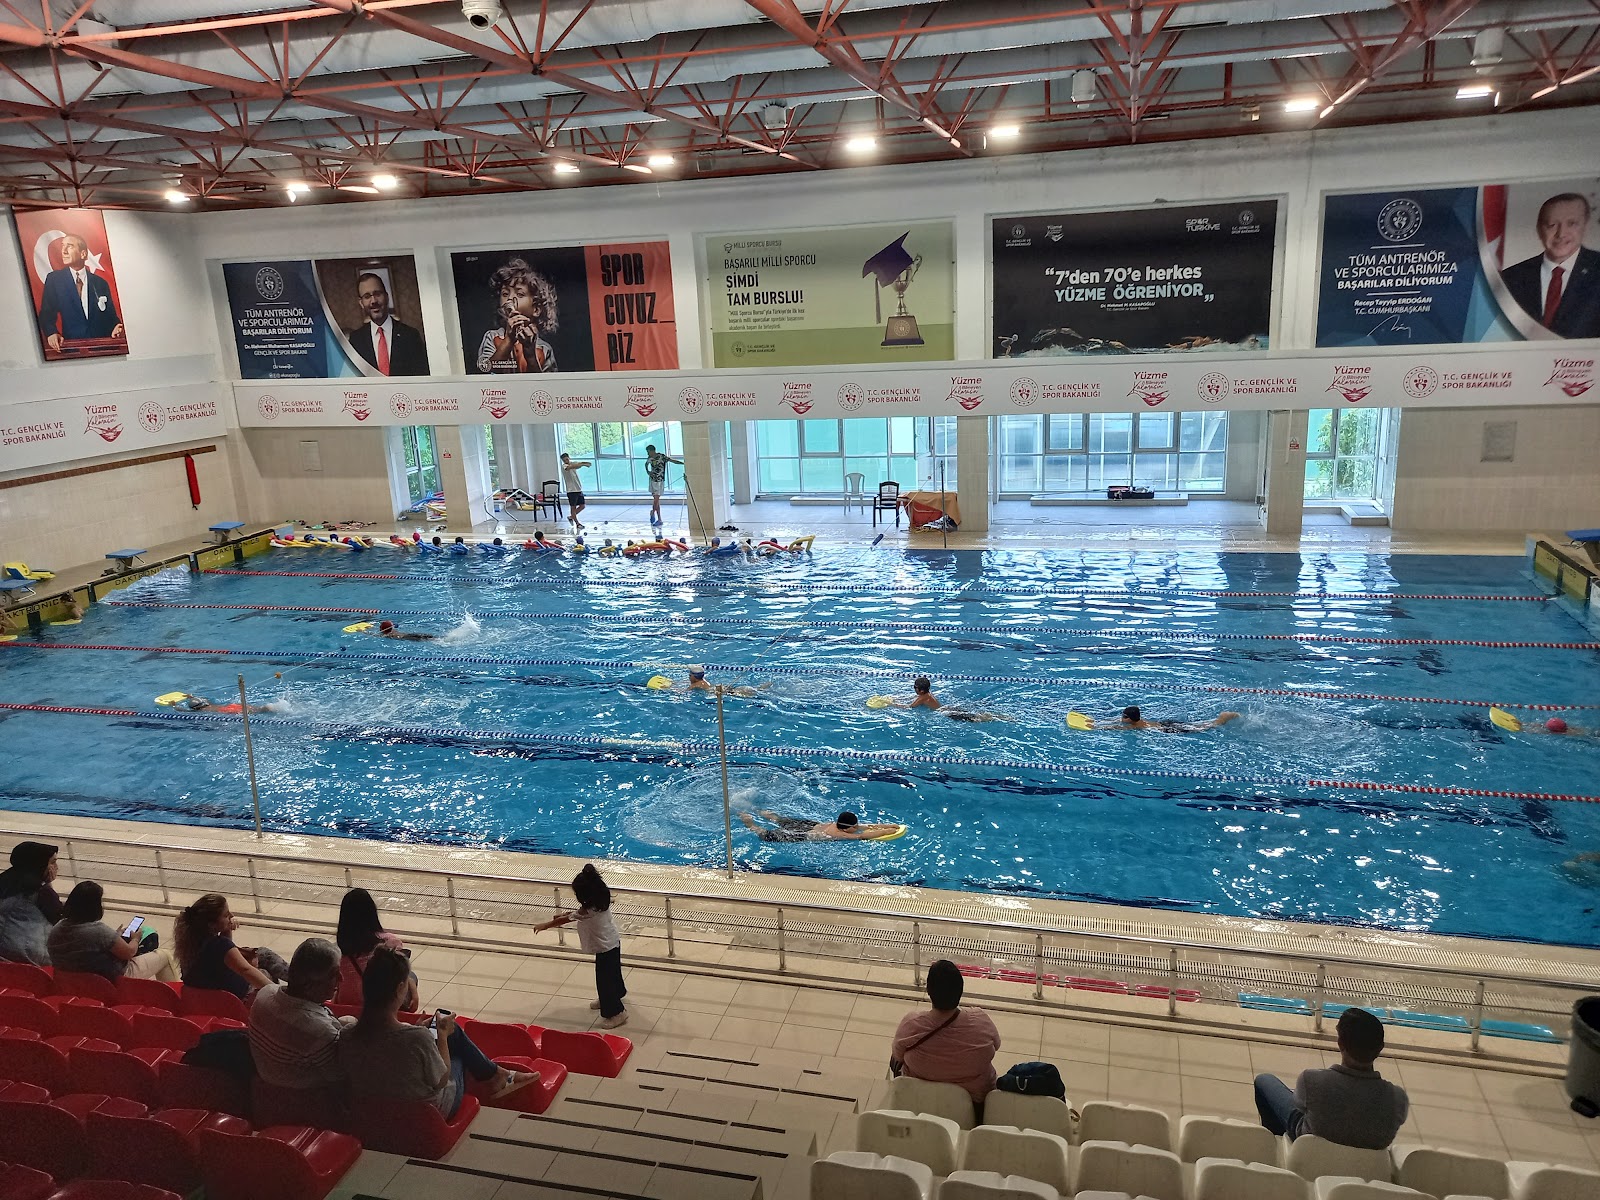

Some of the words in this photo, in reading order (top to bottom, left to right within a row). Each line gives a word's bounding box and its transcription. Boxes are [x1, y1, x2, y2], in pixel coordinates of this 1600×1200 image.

[724, 258, 759, 271] BAŞARILI
[761, 255, 782, 267] MİLLİ
[785, 254, 816, 266] SPORCU
[1349, 254, 1376, 266] TÜM
[1379, 251, 1446, 264] ANTRENÖR
[600, 253, 644, 286] SPOR
[1146, 265, 1201, 280] herkes
[1334, 268, 1351, 278] VE
[1352, 262, 1458, 277] SPORCULARIMIZA
[726, 271, 759, 291] ŞİMDİ
[1338, 279, 1393, 290] BAŞARILAR
[1395, 276, 1453, 287] DİLİYORUM
[727, 293, 750, 306] TAM
[754, 290, 804, 306] BURSLU!
[1055, 286, 1106, 302] YÜZME
[245, 309, 262, 318] TÜM
[263, 307, 304, 317] ANTRENÖR
[1368, 306, 1430, 314] CUMHURBAŞKANI
[238, 319, 249, 327] VE
[250, 316, 313, 327] SPORCULARIMIZA
[243, 328, 277, 337] BAŞARILAR
[277, 326, 312, 335] DİLİYORUM
[607, 330, 635, 364] BİZ
[1554, 359, 1594, 368] Yüzme
[1134, 371, 1168, 379] Yüzme
[1334, 366, 1371, 374] Yüzme
[1461, 372, 1498, 381] GENÇLİK
[1249, 377, 1284, 387] GENÇLİK
[1466, 380, 1512, 388] BAKANLIĞI
[881, 388, 910, 396] GENÇLİK
[1057, 383, 1089, 392] GENÇLİK
[1255, 385, 1297, 394] BAKANLIĞI
[567, 395, 593, 403] GENÇLİK
[719, 391, 747, 400] GENÇLİK
[885, 395, 921, 403] BAKANLIĞI
[1062, 390, 1100, 398] BAKANLIĞI
[291, 400, 313, 408] GENÇLİK
[425, 398, 448, 406] GENÇLİK
[84, 404, 117, 415] Yüzme
[180, 403, 207, 412] GENÇLİK
[169, 414, 185, 422] SPOR
[185, 409, 217, 420] BAKANLIĞI
[1, 427, 16, 437] T.C.
[17, 422, 52, 434] GENÇLİK
[54, 421, 64, 429] VE
[3, 437, 24, 446] SPOR
[25, 430, 67, 443] BAKANLIĞI
[116, 562, 121, 570] 2
[7, 599, 59, 619] AKTRONIC
